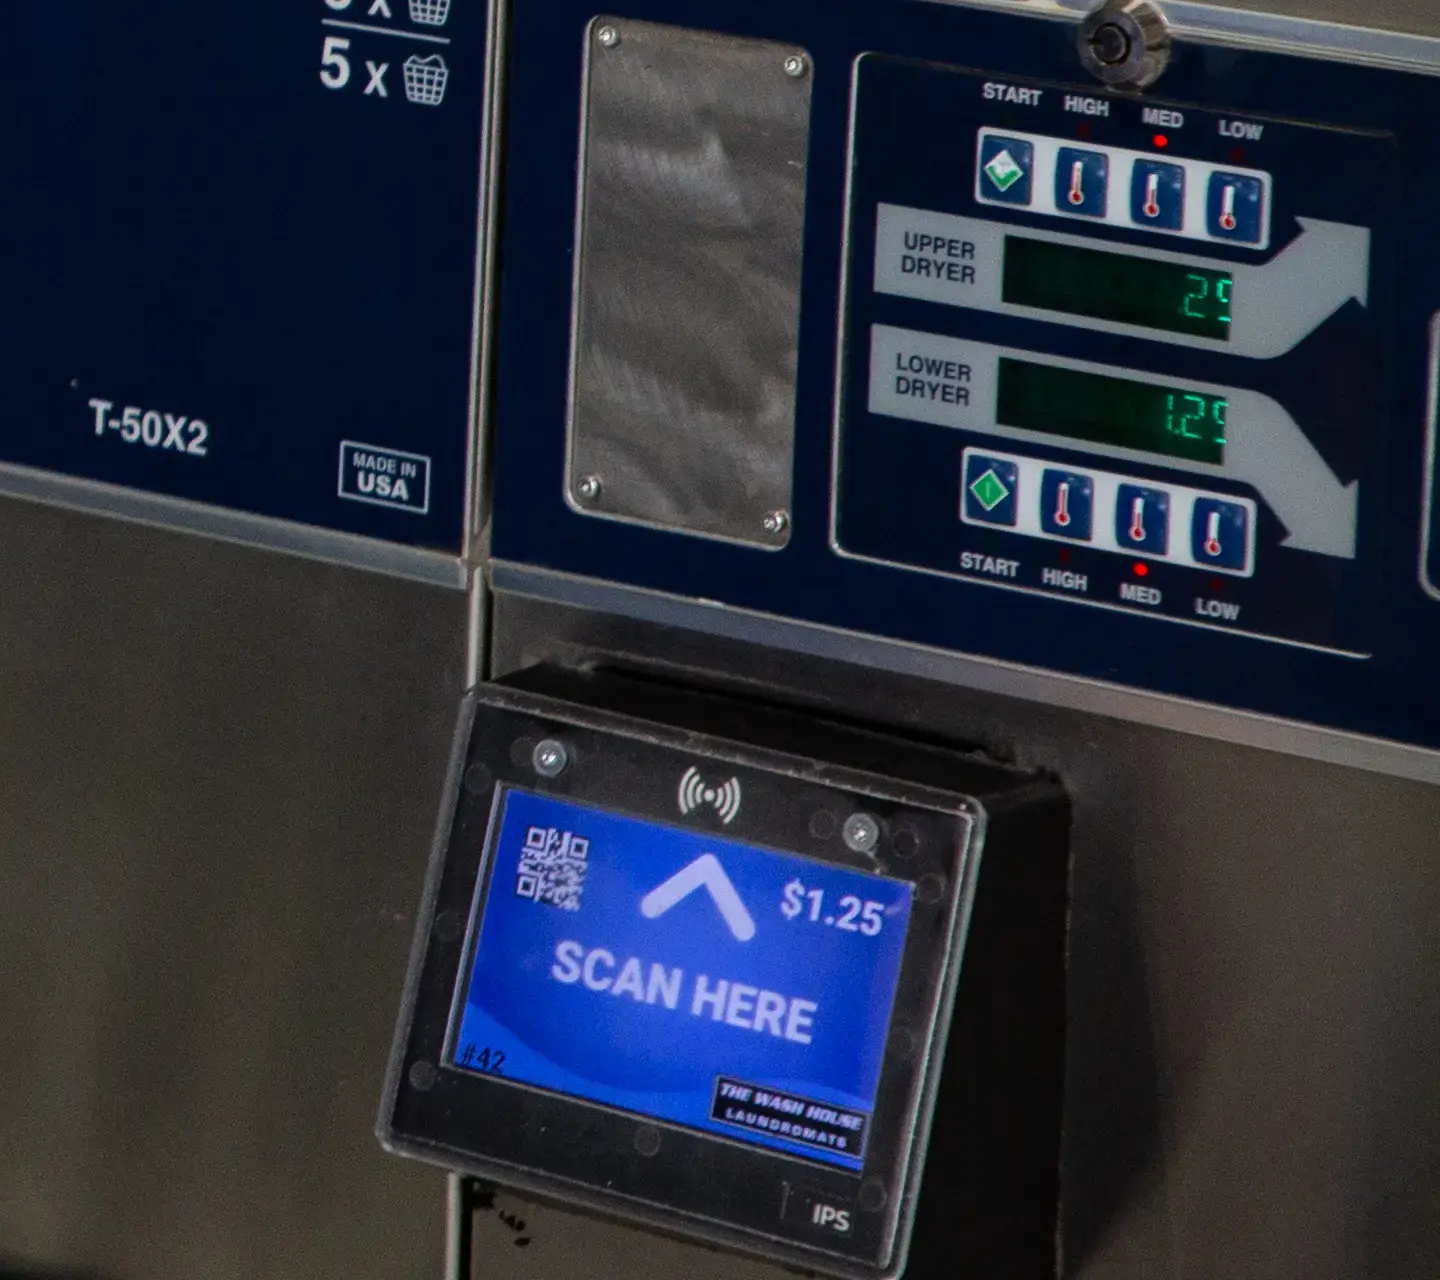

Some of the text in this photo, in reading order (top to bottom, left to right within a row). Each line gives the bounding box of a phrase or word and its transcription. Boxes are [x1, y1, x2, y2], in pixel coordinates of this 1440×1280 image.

[320, 36, 388, 98] 5 x
[983, 83, 1263, 141] START HIGH MED LOW
[904, 231, 975, 260] UPPER
[901, 255, 975, 285] DRYER
[896, 353, 972, 383] LOWER
[895, 377, 970, 407] DRYER
[89, 398, 208, 455] T-50X2
[353, 451, 416, 479] MADE IN
[357, 474, 408, 501] USA
[960, 552, 1240, 621] START HIGH MED LOW
[781, 878, 884, 937] $1.25
[552, 940, 818, 1045] SCAN HERE
[720, 1081, 864, 1131] THE WASH HOUSE
[725, 1107, 848, 1149] LAUNDROMATS
[812, 1203, 850, 1232] IPS
